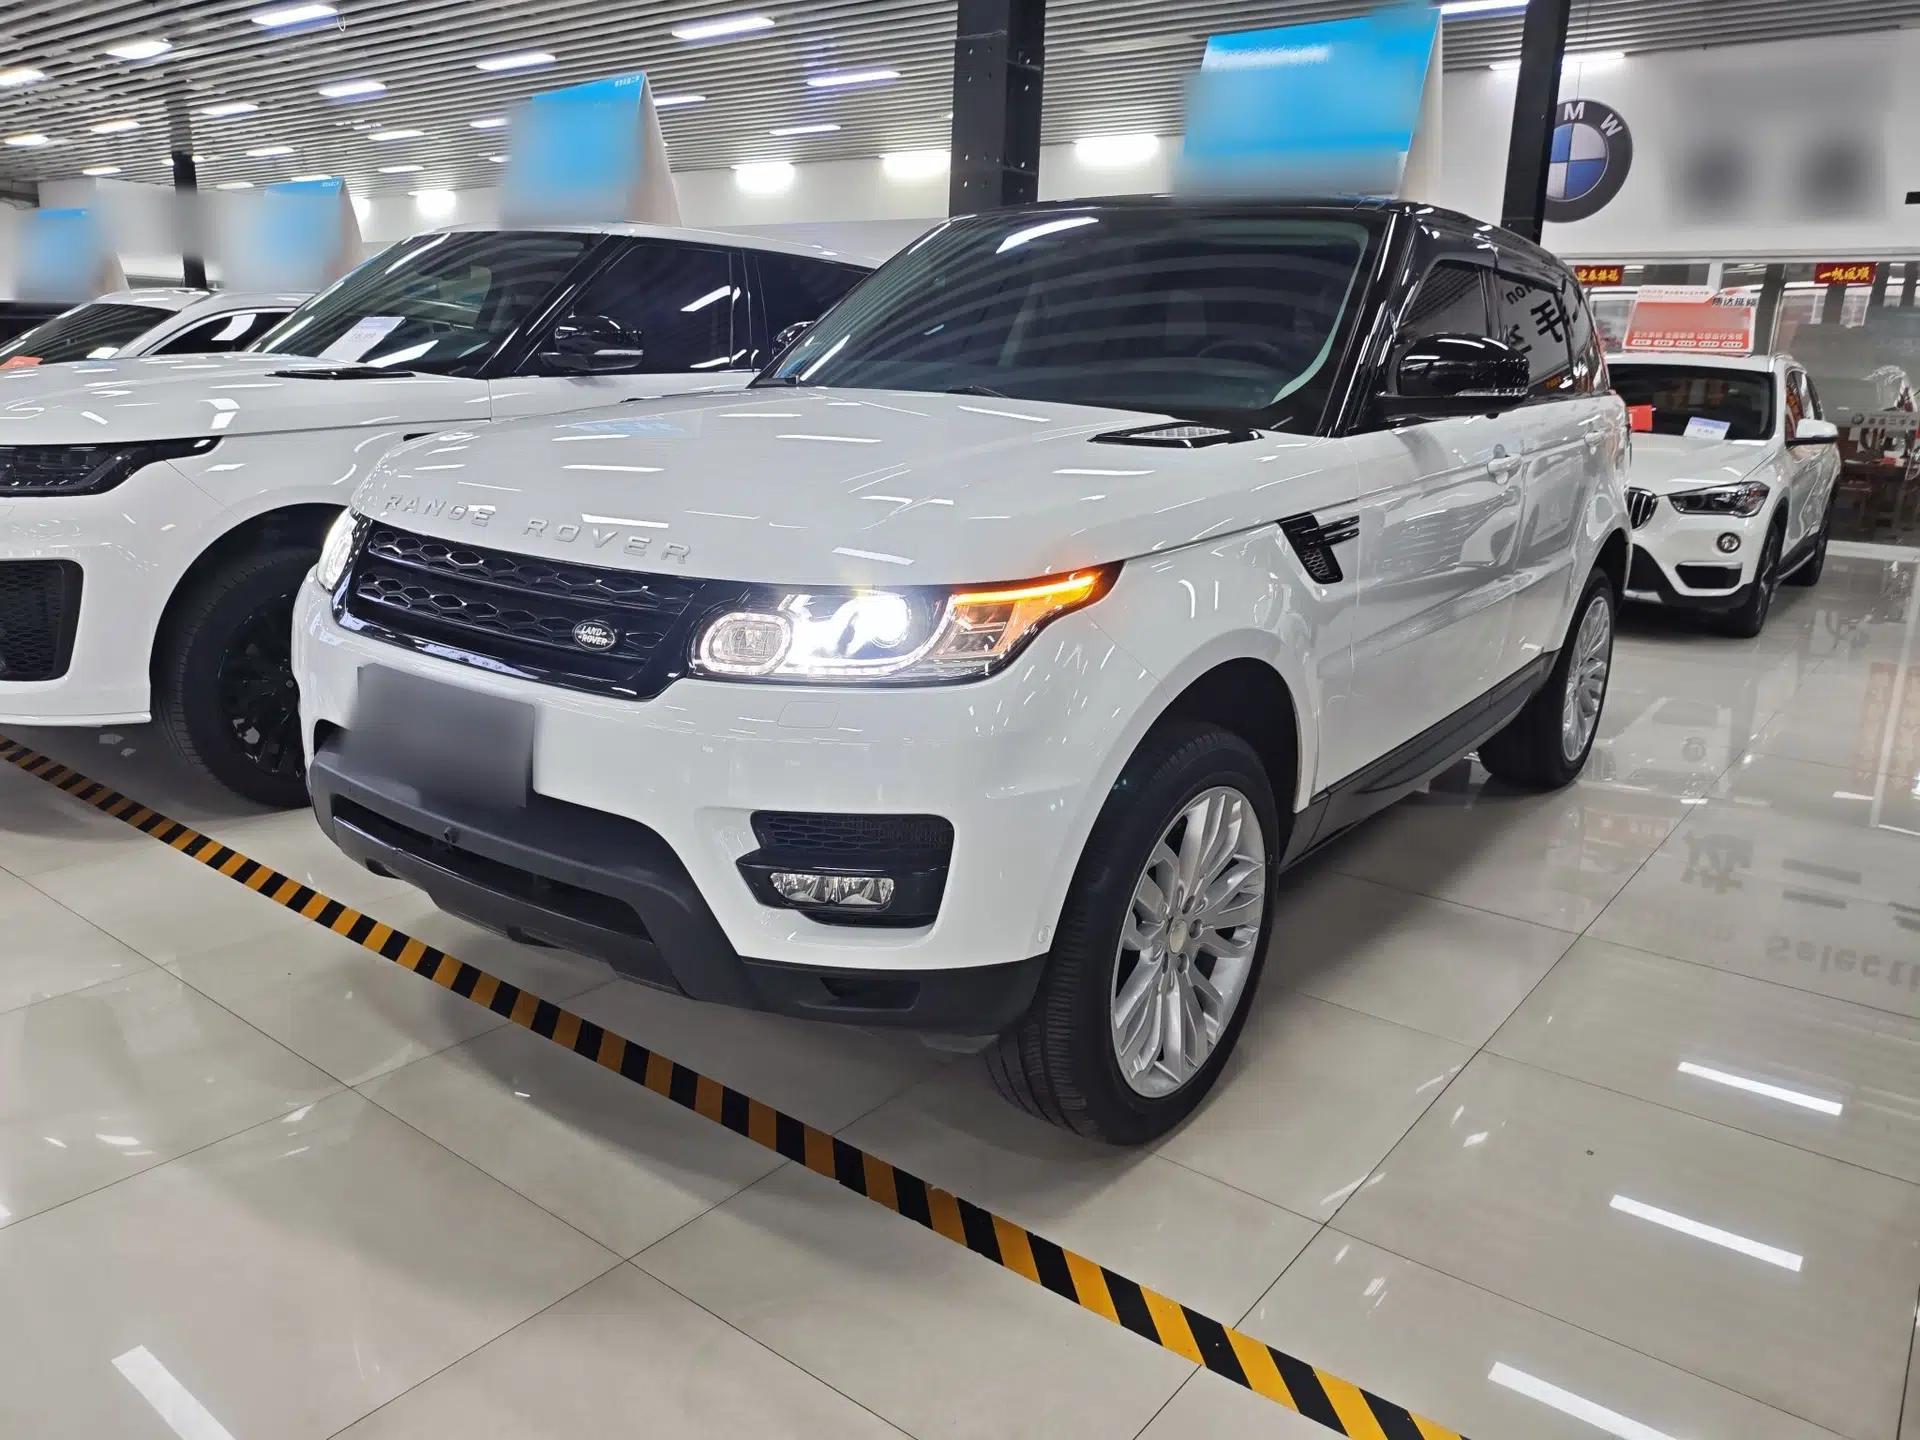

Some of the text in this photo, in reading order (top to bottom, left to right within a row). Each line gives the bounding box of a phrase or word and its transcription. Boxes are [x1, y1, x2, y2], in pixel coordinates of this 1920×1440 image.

[1564, 102, 1623, 137] MW
[384, 495, 692, 565] RANGE ROVER
[581, 625, 603, 636] LAND
[581, 634, 608, 646] ROVER
